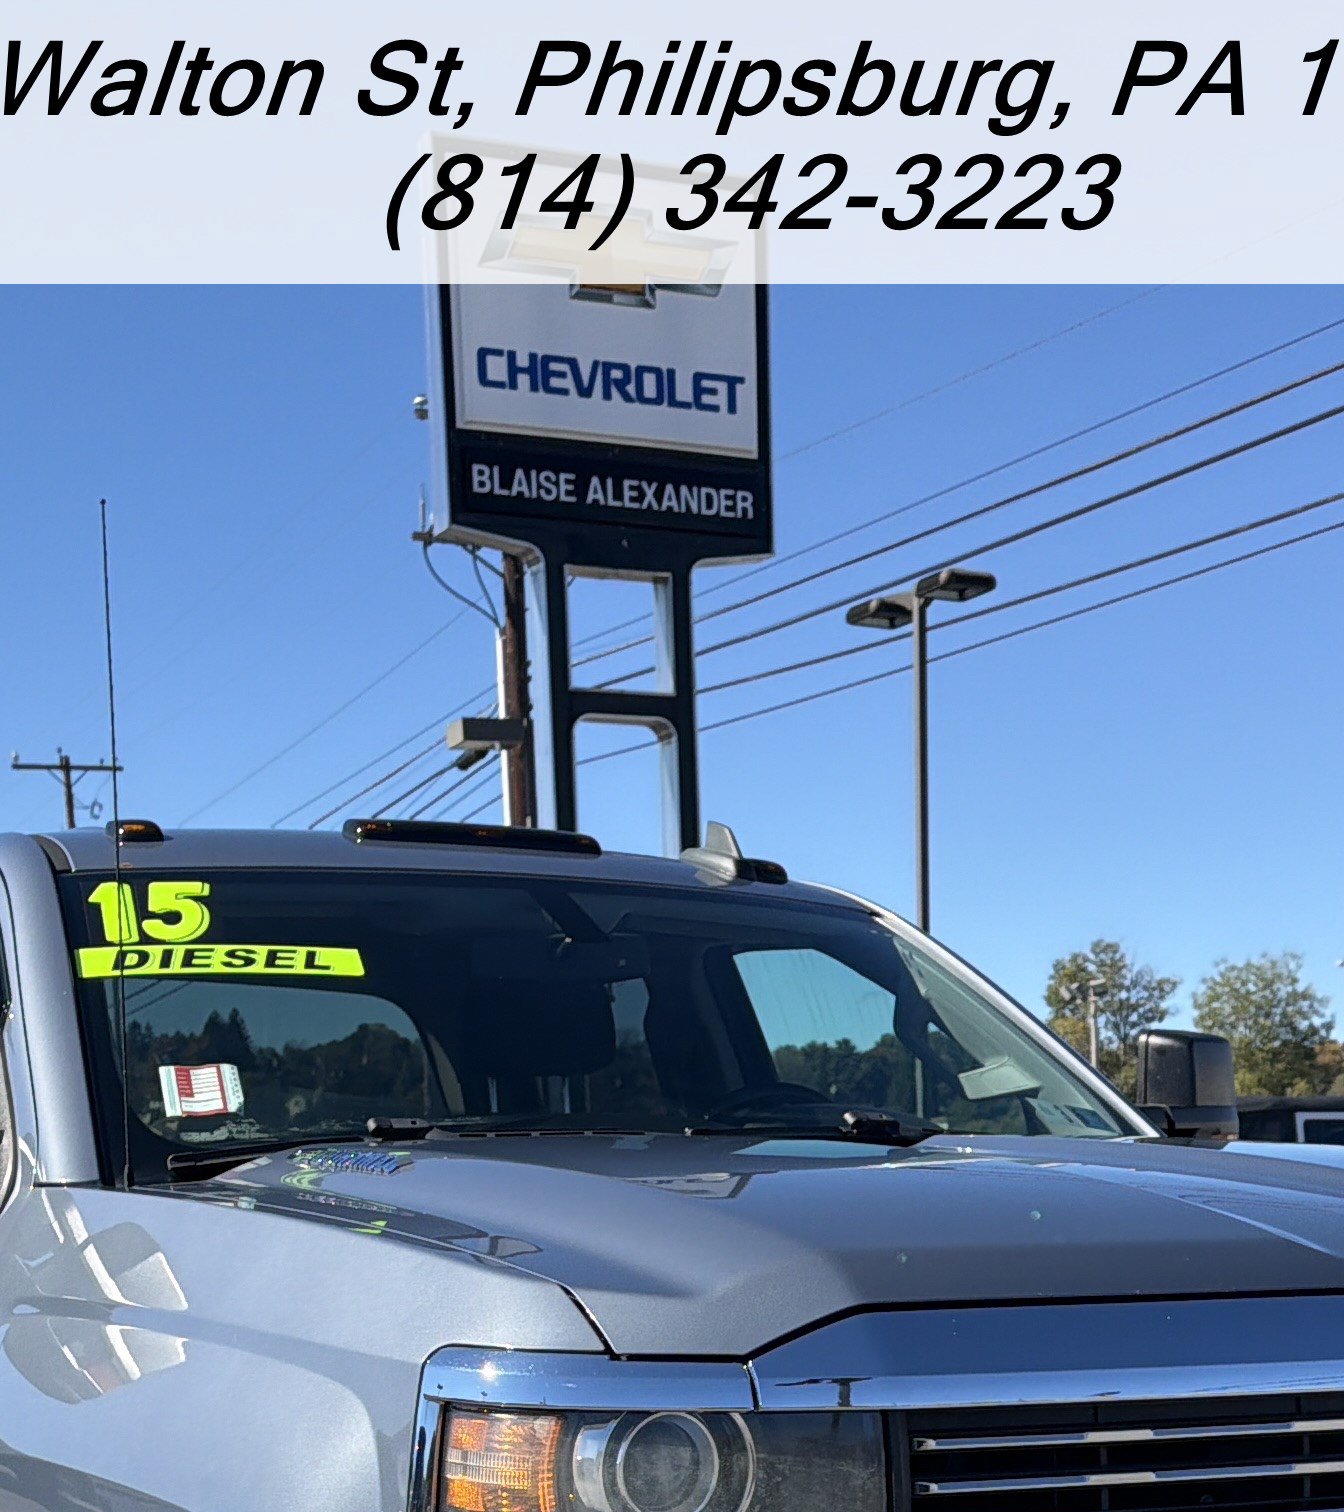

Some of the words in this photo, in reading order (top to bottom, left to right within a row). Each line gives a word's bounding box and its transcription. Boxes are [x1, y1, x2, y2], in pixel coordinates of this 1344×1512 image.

[476, 347, 745, 414] CHEVROLET
[472, 463, 577, 503] BLAISE
[586, 475, 754, 519] ALEXANDER
[88, 881, 210, 944] 15
[111, 947, 333, 972] DIESEL
